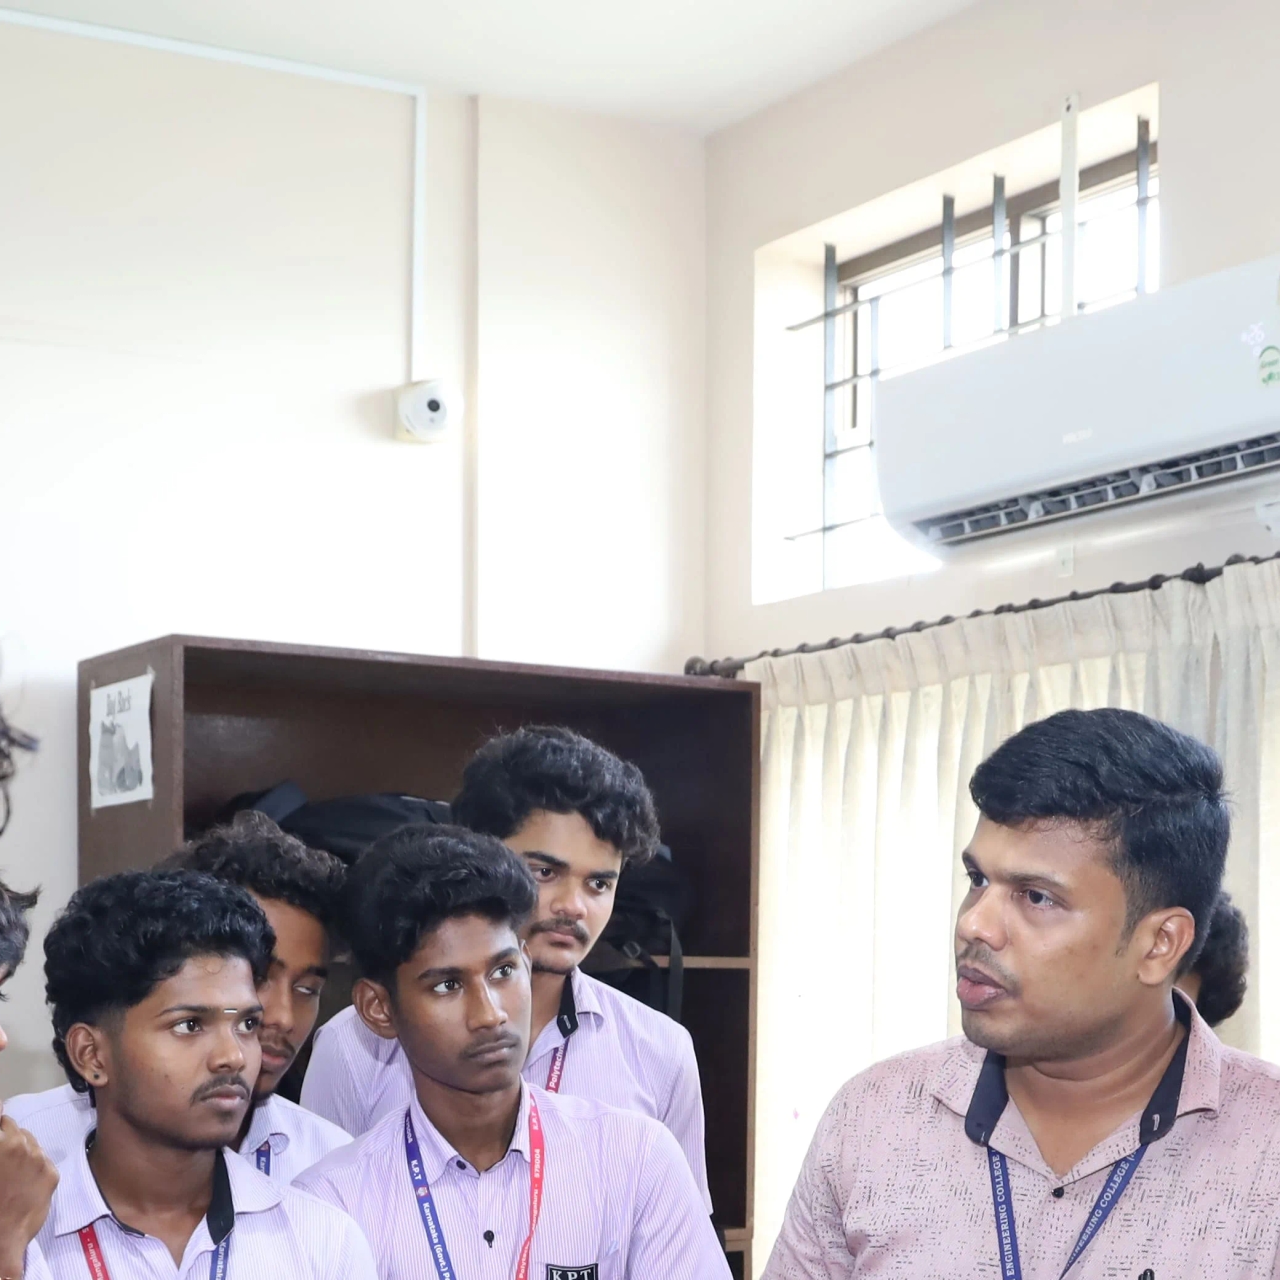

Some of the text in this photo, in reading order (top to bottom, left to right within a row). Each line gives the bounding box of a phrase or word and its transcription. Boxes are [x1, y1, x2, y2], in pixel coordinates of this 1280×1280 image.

[549, 1043, 565, 1089] Polytechn
[411, 1159, 422, 1180] K.P.T
[992, 1154, 1006, 1203] COLLEGE
[423, 1202, 439, 1244] Karnataka
[434, 1244, 448, 1272] (Govt.)
[999, 1204, 1016, 1277] ENGINEERING
[1067, 1209, 1103, 1268] INEERING
[1100, 1161, 1130, 1208] COLLEGE
